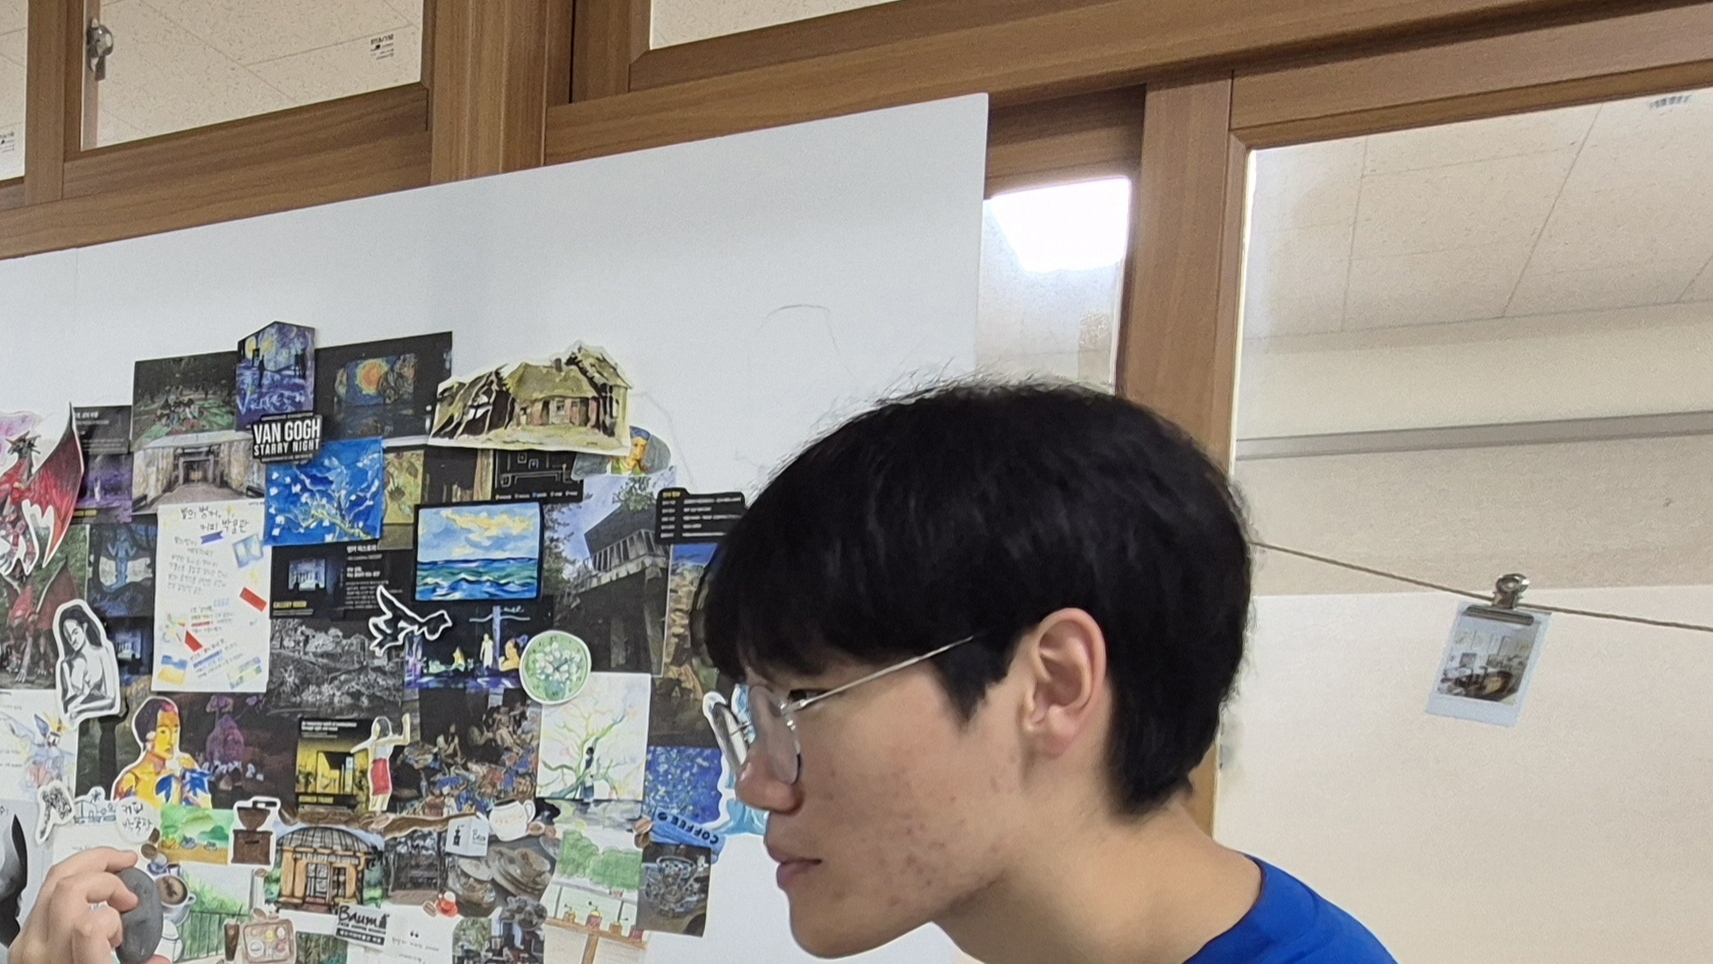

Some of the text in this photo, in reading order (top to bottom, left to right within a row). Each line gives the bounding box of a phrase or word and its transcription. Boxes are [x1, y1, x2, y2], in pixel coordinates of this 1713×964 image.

[253, 418, 321, 444] VAN GOGH
[253, 438, 320, 456] STARRY NIGHT
[670, 815, 719, 845] COFFEE
